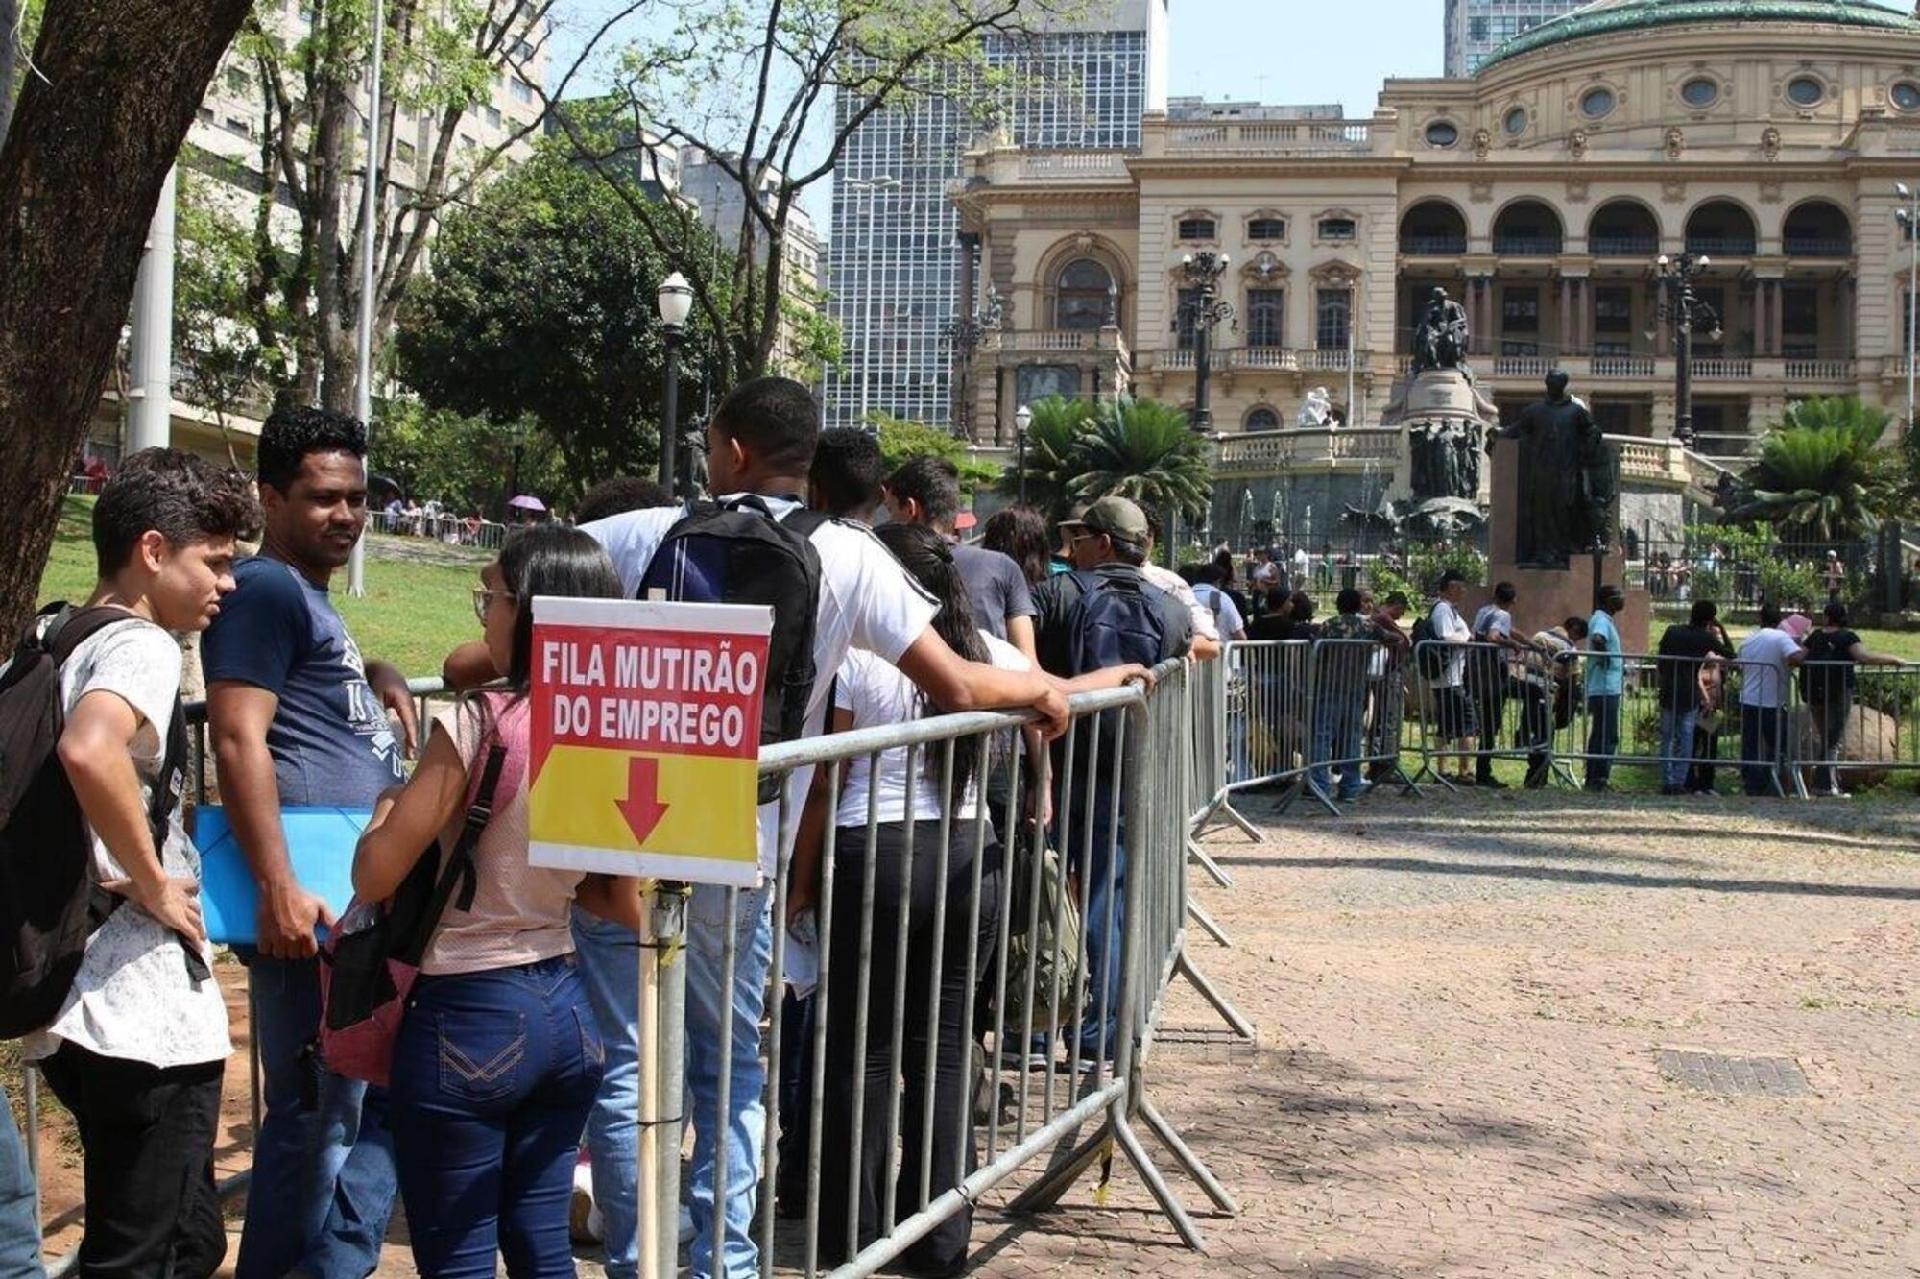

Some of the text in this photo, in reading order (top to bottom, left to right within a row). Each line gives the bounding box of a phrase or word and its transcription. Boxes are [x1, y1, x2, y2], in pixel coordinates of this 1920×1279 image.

[542, 640, 758, 696] FILA MUTIRÃO
[553, 694, 744, 747] DO EMPREGO
